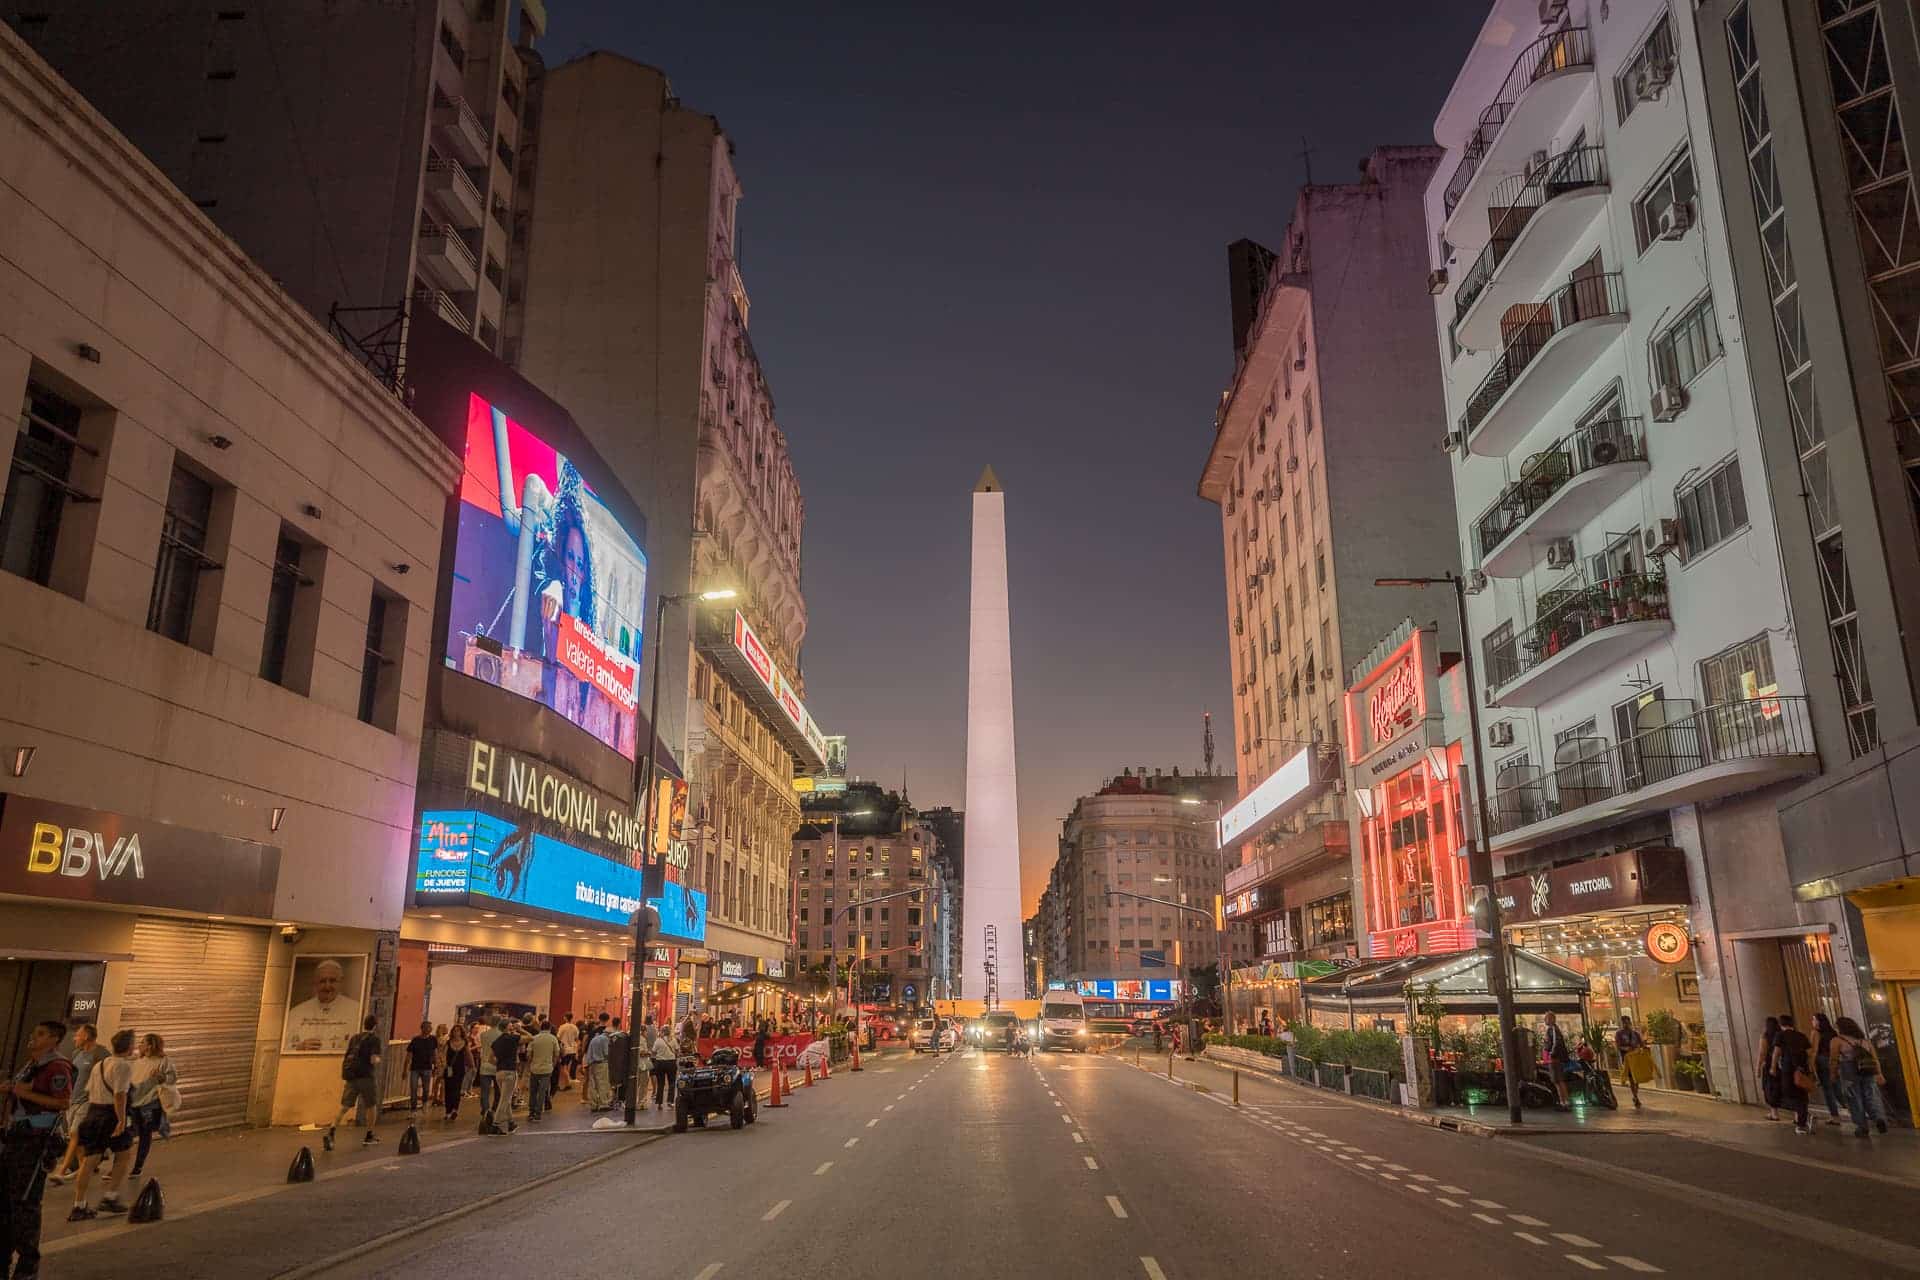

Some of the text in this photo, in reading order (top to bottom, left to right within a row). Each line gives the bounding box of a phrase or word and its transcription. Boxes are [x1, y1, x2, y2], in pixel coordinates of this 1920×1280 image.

[566, 639, 635, 710] valeria ambrosio
[472, 740, 500, 797] EL
[507, 757, 601, 838] NACIONAL
[28, 822, 144, 880] BBVA
[425, 869, 467, 877] FUNCIONES
[436, 878, 466, 886] JUEVES
[576, 881, 595, 903] tributo
[600, 887, 606, 907] la
[606, 893, 619, 912] gran
[1570, 876, 1612, 896] TRATTORIA
[74, 999, 97, 1011] BBVA
